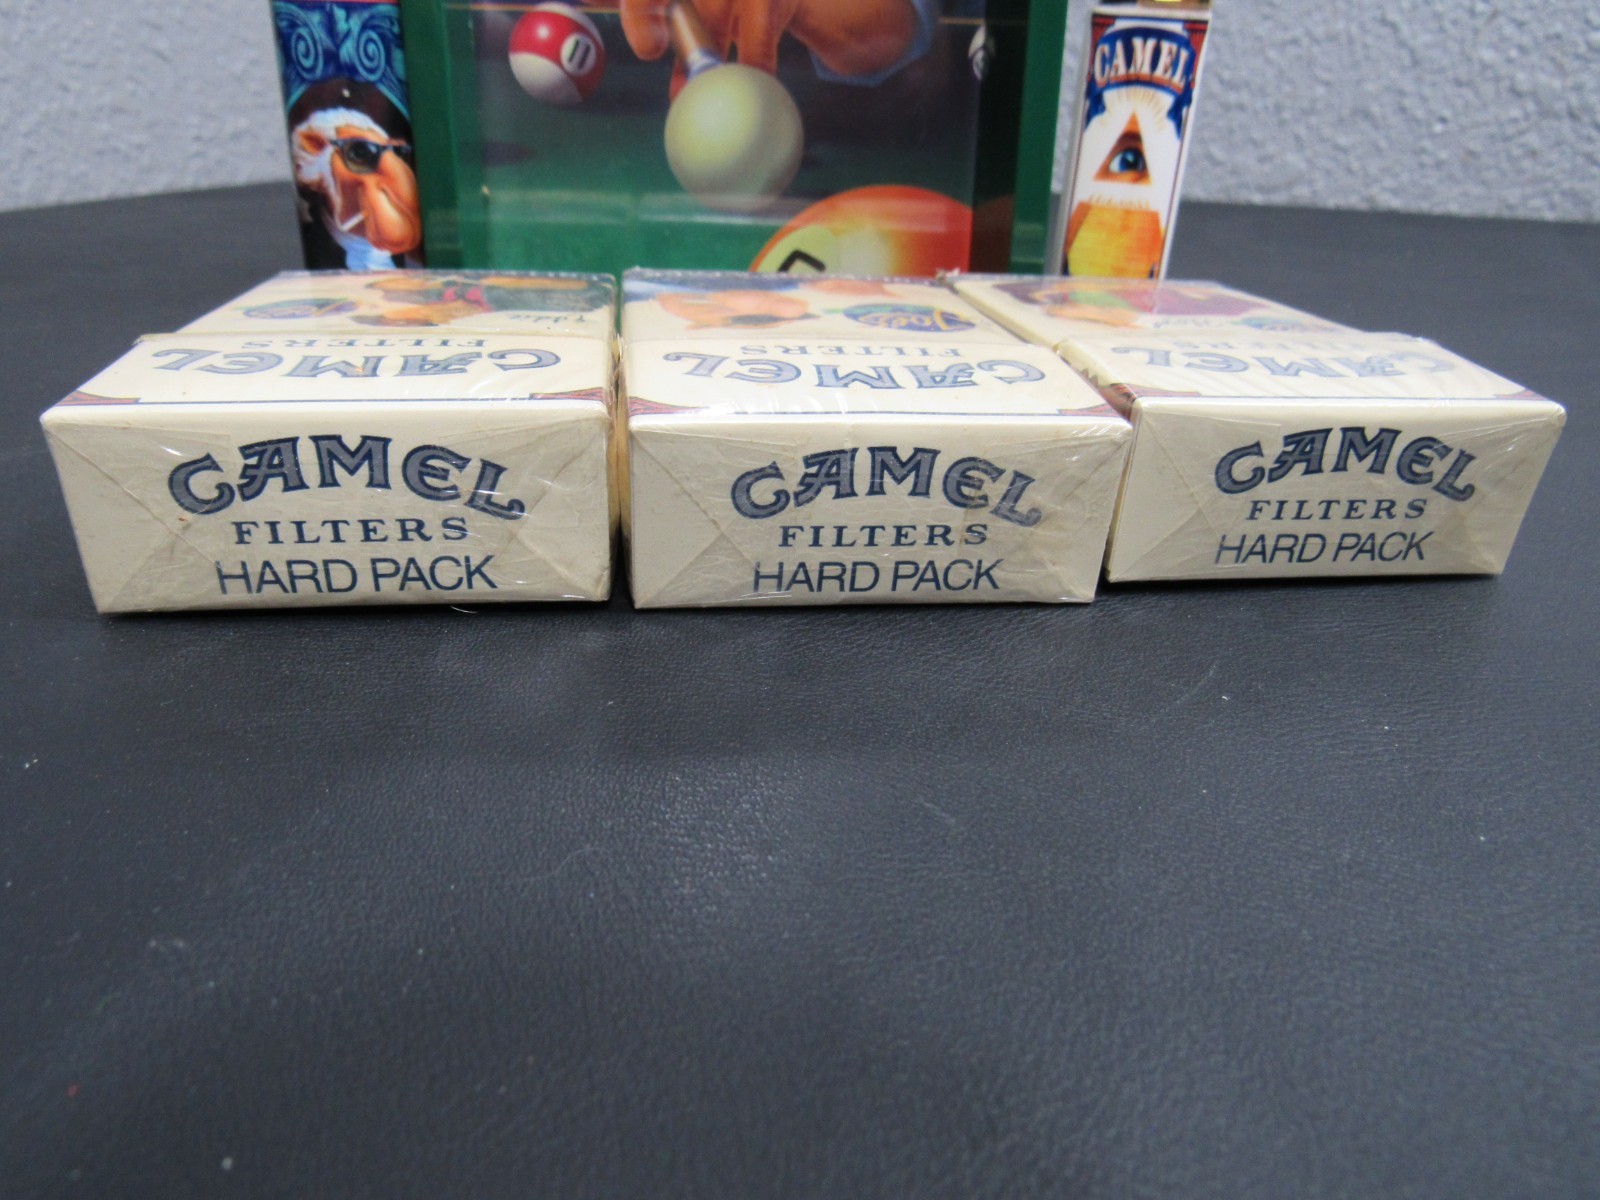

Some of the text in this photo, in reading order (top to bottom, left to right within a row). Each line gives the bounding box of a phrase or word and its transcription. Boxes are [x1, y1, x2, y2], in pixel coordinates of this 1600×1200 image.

[1094, 37, 1189, 94] CAMEL
[241, 339, 487, 348] FILTERS
[741, 345, 962, 356] FILTERS
[152, 348, 561, 378] CAMEL
[663, 351, 1046, 389] CAMEL
[1111, 346, 1457, 378] CAMEL
[168, 435, 525, 520] CAMEL
[1214, 426, 1476, 500] CAMEL
[731, 446, 1042, 527] CAMEL
[1246, 499, 1426, 520] FILTERS
[233, 517, 469, 545] FILTERS
[779, 523, 988, 547] FILTERS
[1214, 531, 1434, 564] HARD PACK
[215, 555, 498, 595] HARD PACK
[753, 558, 1004, 593] HARD PACK
